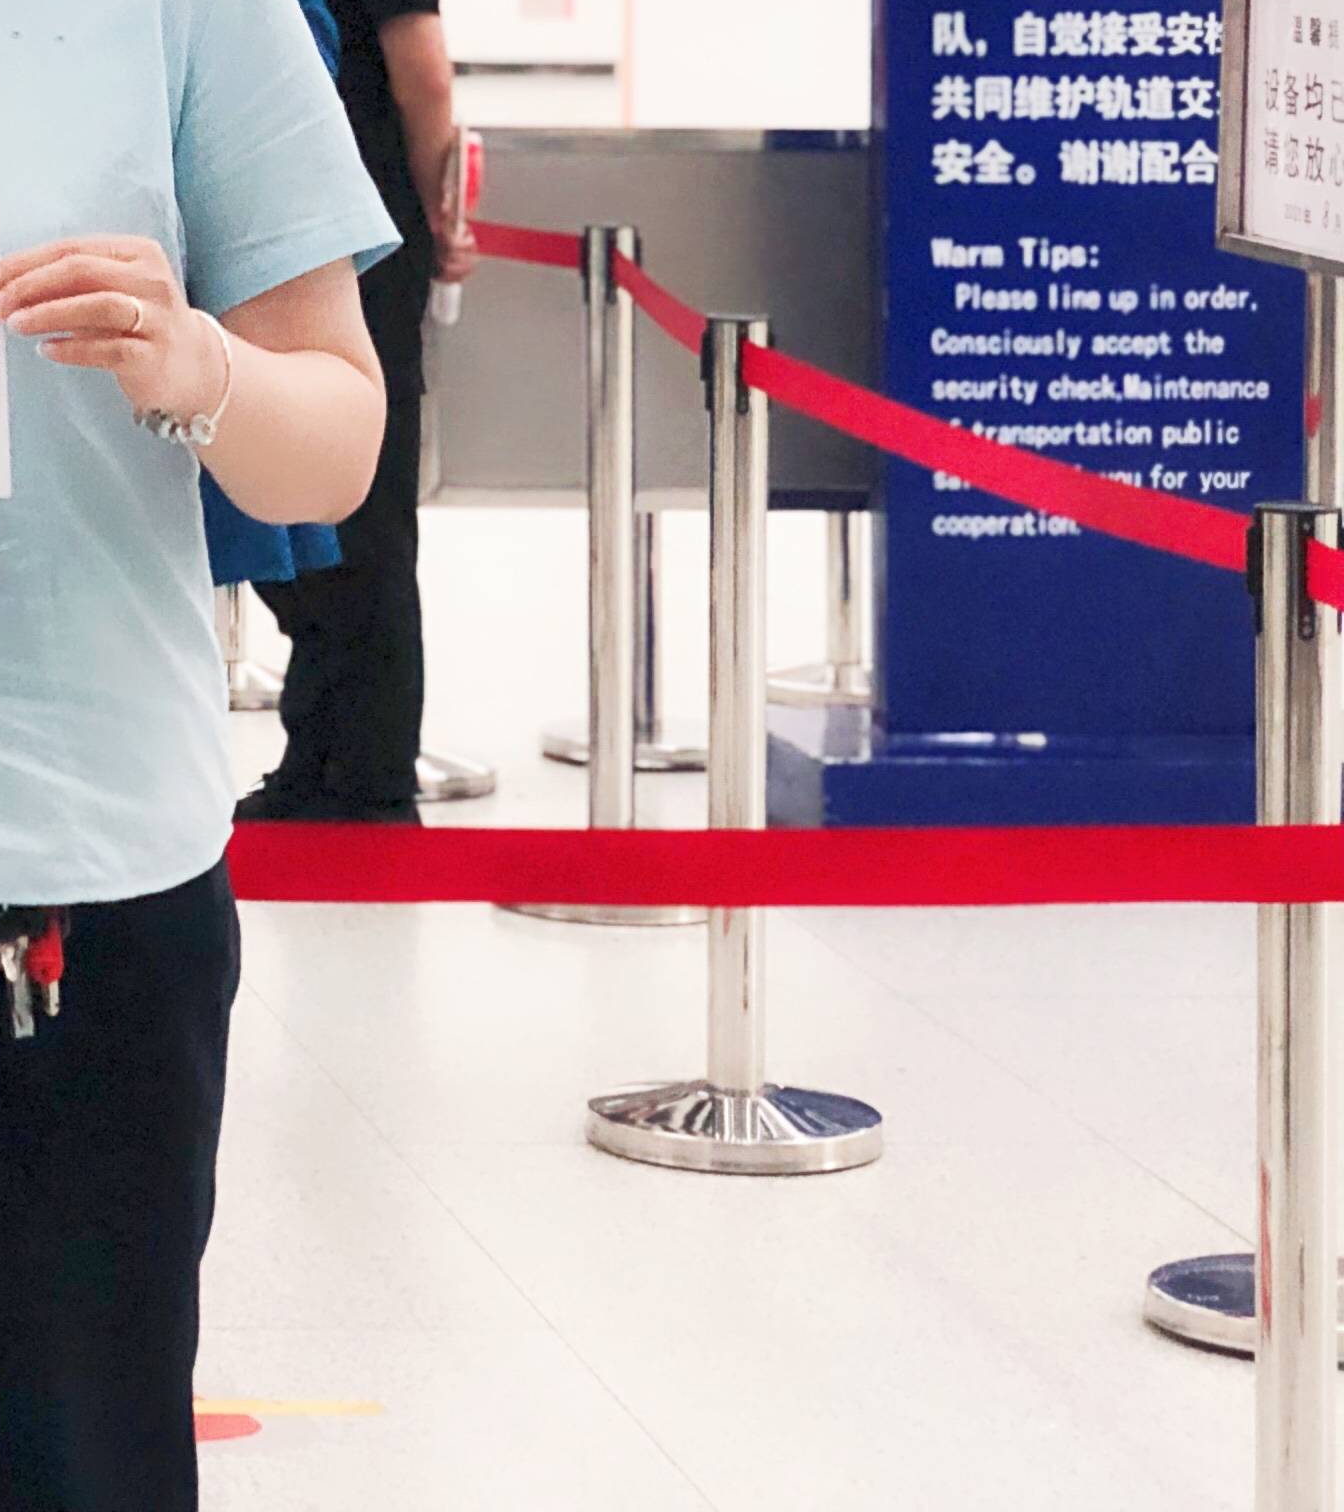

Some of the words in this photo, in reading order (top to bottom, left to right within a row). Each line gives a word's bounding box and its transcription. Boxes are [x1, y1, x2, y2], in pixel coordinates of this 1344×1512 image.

[932, 75, 1220, 121] 共同维护轨道交
[930, 238, 1004, 267] Warm
[1018, 238, 1099, 272] Tips:
[955, 283, 1037, 310] Please
[1049, 283, 1101, 310] line
[1109, 290, 1139, 314] up
[1150, 283, 1176, 310] in
[930, 328, 1081, 359] Consciously
[1091, 331, 1172, 359] accept
[1184, 329, 1225, 354] the
[931, 373, 1038, 405] security
[1161, 420, 1239, 448] public
[1150, 463, 1186, 489] for
[1200, 469, 1251, 493] your
